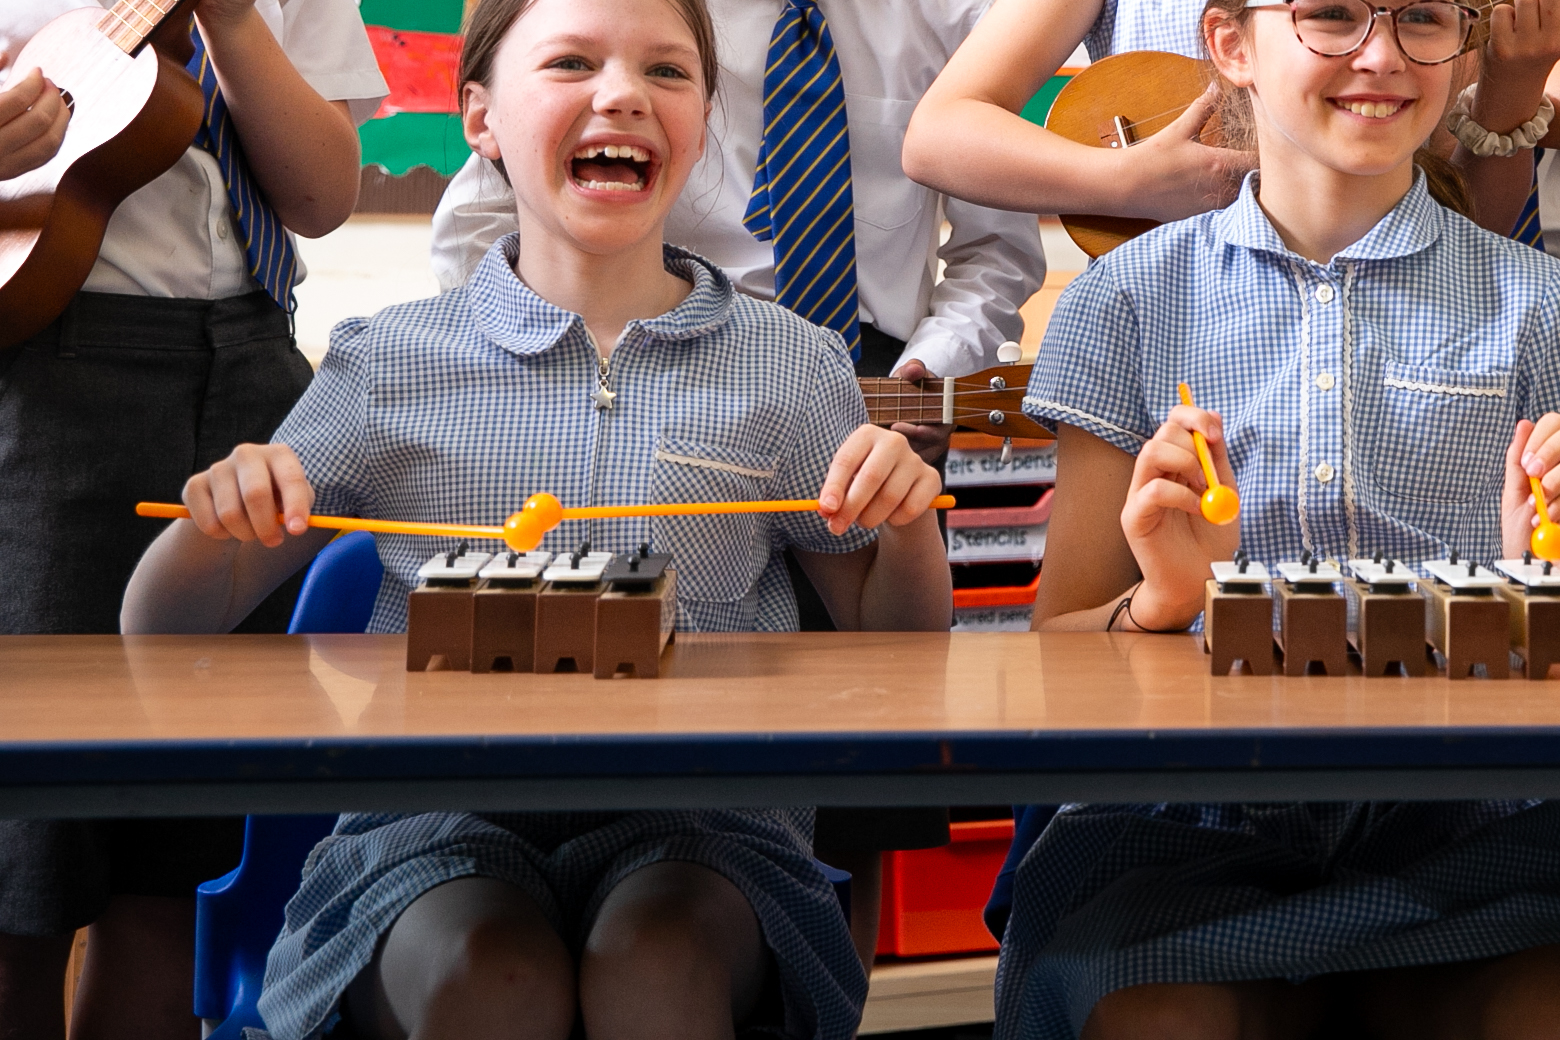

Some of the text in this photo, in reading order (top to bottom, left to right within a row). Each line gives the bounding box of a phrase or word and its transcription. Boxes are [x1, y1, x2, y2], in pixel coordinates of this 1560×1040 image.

[947, 456, 974, 475] elt
[1012, 452, 1054, 473] pens
[952, 528, 1027, 551] Stencils
